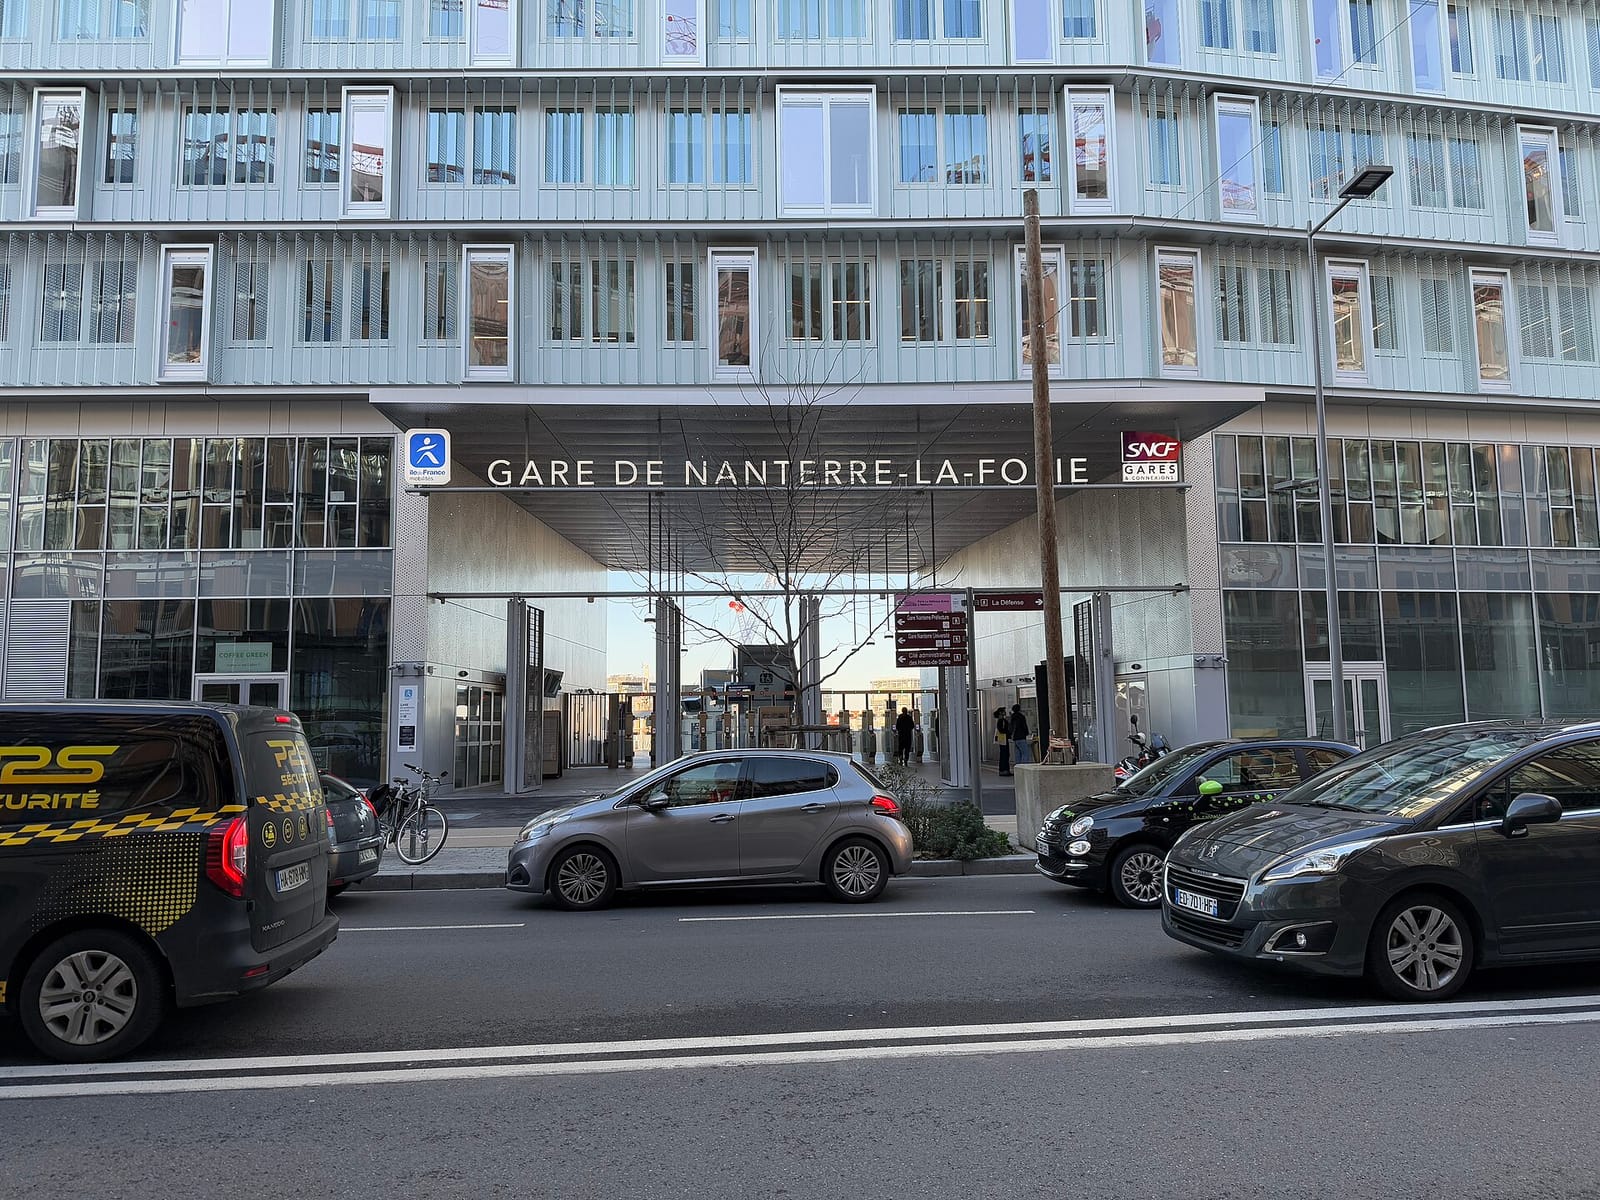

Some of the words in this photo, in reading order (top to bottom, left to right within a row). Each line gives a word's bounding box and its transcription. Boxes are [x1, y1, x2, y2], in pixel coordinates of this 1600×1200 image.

[1125, 442, 1178, 457] SNCF
[487, 459, 595, 486] GARE
[615, 460, 664, 486] DE
[685, 458, 1089, 486] NANTERRE-LA-FOIE
[1124, 465, 1176, 474] GARES
